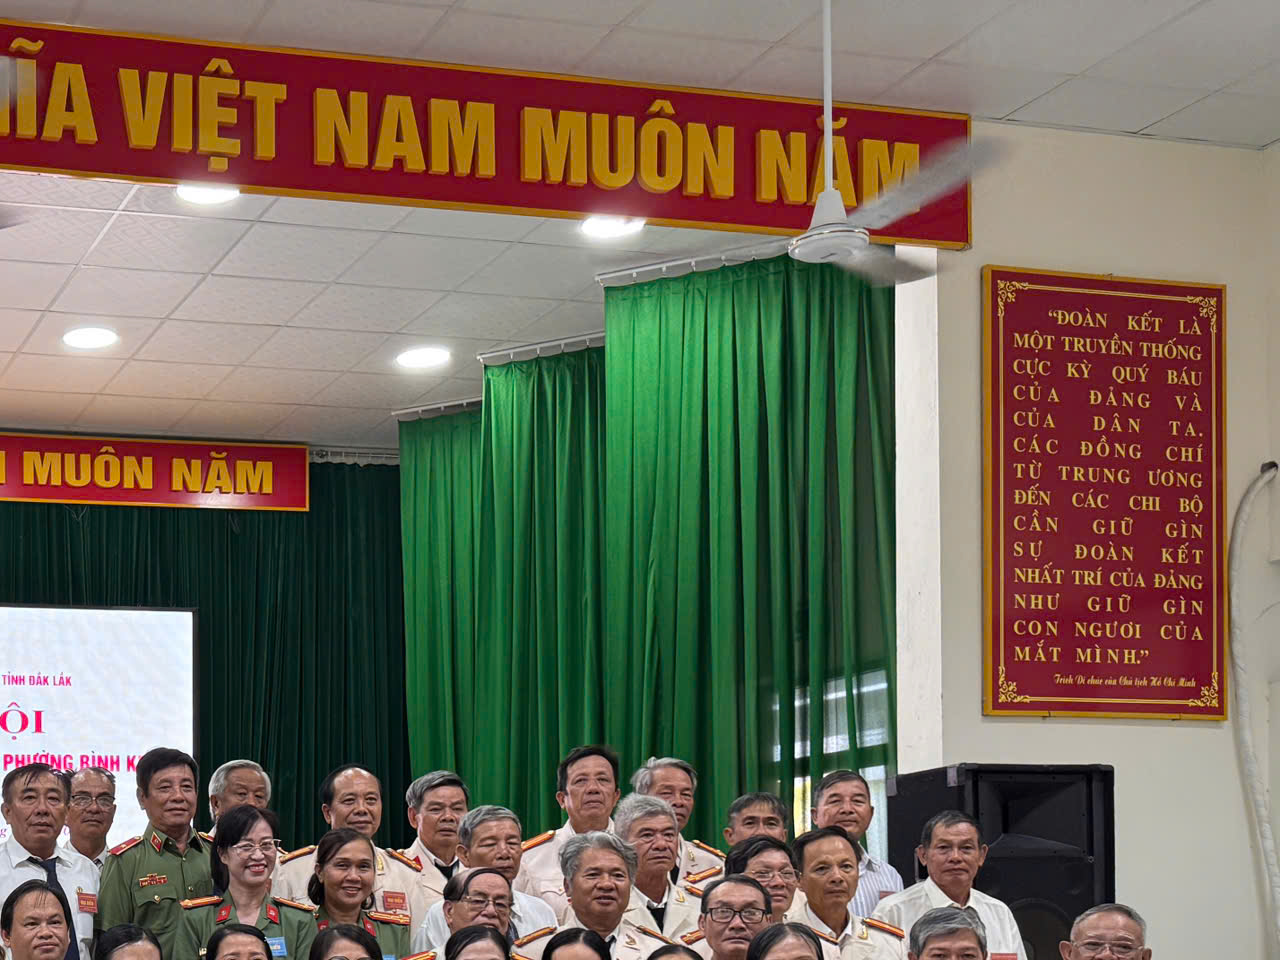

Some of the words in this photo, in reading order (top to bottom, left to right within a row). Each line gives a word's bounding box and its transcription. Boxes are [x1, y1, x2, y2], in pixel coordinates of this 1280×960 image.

[118, 58, 286, 172] VIỆT
[313, 88, 496, 179] NAM
[521, 98, 735, 200] MUÔN
[756, 116, 920, 211] NĂM
[1128, 311, 1162, 332] KẾT
[1180, 317, 1201, 335] LÀ
[1014, 330, 1055, 352] MỘT
[1061, 333, 1132, 355] TRUYỀN
[1140, 338, 1201, 360] THỐNG
[1014, 358, 1050, 378] CỰC
[1068, 360, 1091, 378] KỲ
[1112, 364, 1148, 384] QUÝ
[1168, 367, 1201, 385] BÁU
[1013, 382, 1059, 402] CỦA
[1090, 387, 1150, 408] ĐẢNG
[1176, 393, 1202, 411] VÀ
[1014, 408, 1055, 427] CỦA
[1094, 413, 1139, 432] DÂN
[1169, 421, 1202, 436] TA.
[1014, 434, 1058, 454] CÁC
[1081, 435, 1141, 458] ĐỒNG
[1166, 444, 1202, 462] CHÍ
[24, 446, 152, 489] MUÔN
[172, 452, 272, 499] NĂM
[1014, 460, 1041, 479] TỪ
[1059, 466, 1129, 484] TRUNG
[1149, 469, 1202, 488] ƯƠNG
[1015, 484, 1050, 505] ĐẾN
[1072, 489, 1108, 508] CÁC
[1129, 496, 1160, 511] CHI
[1180, 495, 1203, 517] BỘ
[1014, 509, 1057, 532] CẦN
[1093, 517, 1133, 535] GIỮ
[1166, 520, 1202, 538] GÌN
[1014, 541, 1042, 560] SỰ
[1075, 542, 1133, 560] ĐOÀN
[1162, 542, 1203, 564] KẾT
[1015, 562, 1064, 584] NHẤT
[1072, 567, 1101, 585] TRÍ
[1110, 568, 1145, 587] CỦA
[1154, 570, 1202, 589] ĐẢNG
[1015, 593, 1059, 609] NHƯ
[1088, 594, 1130, 612] GIỮ
[1163, 596, 1202, 614] GÌN
[1014, 620, 1057, 635] CON
[1160, 621, 1203, 640] CỦA
[1015, 640, 1061, 661] MẮT
[2, 675, 25, 685] TỈNH
[29, 676, 49, 685] ĐẮK
[53, 676, 71, 686] LẮK
